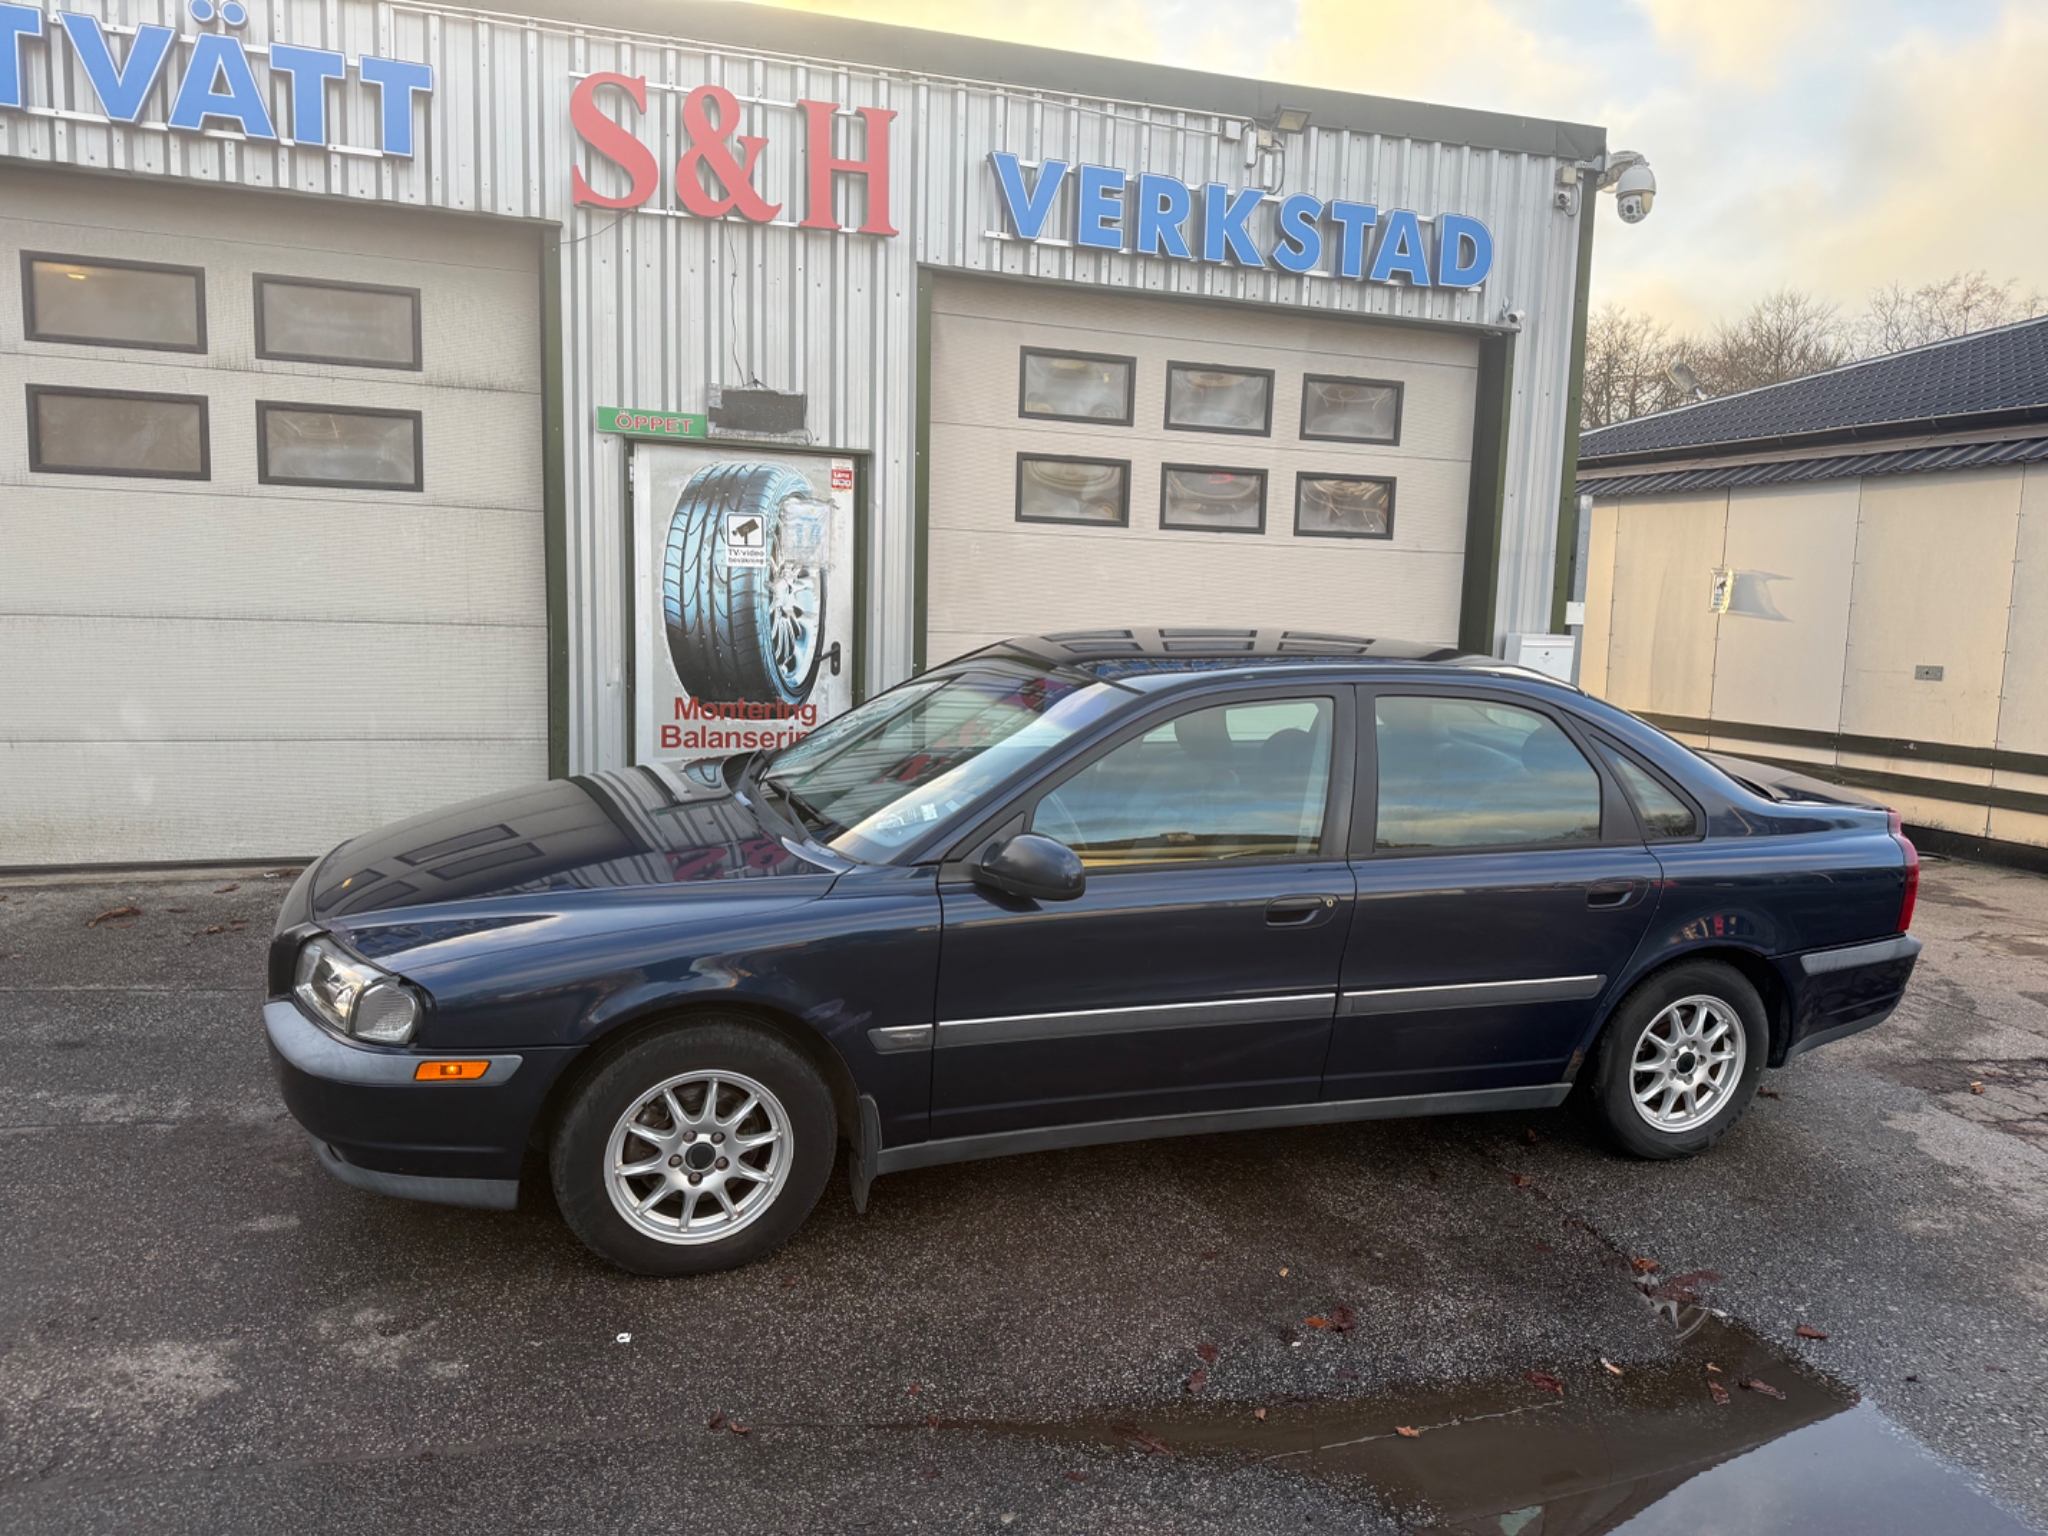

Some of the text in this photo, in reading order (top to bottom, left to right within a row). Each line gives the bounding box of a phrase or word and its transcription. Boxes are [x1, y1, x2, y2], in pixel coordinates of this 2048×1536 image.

[569, 72, 900, 236] S&H
[986, 150, 1495, 289] VERKSTAD
[615, 410, 694, 434] ÖPPET
[674, 697, 817, 727] Montering
